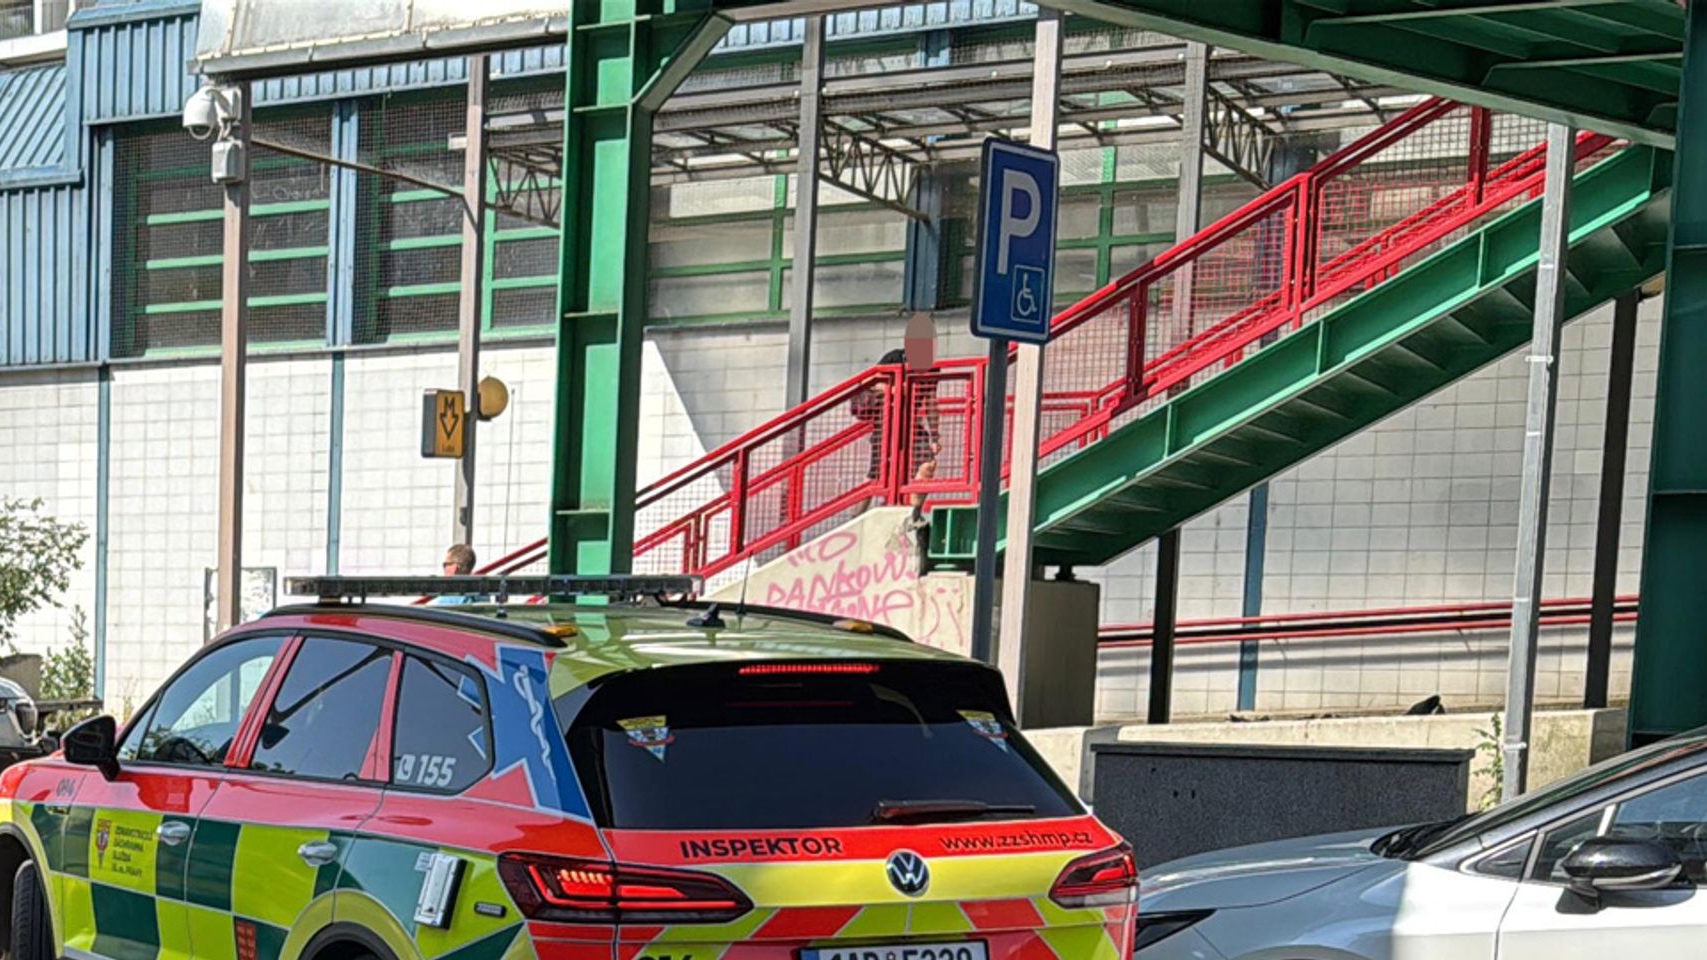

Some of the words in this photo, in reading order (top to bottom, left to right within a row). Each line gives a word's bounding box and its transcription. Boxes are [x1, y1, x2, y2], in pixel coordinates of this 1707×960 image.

[997, 168, 1042, 275] P
[416, 754, 457, 787] 155
[680, 836, 843, 858] INSPEKTOR
[938, 830, 1094, 850] www.zzshmp.cz
